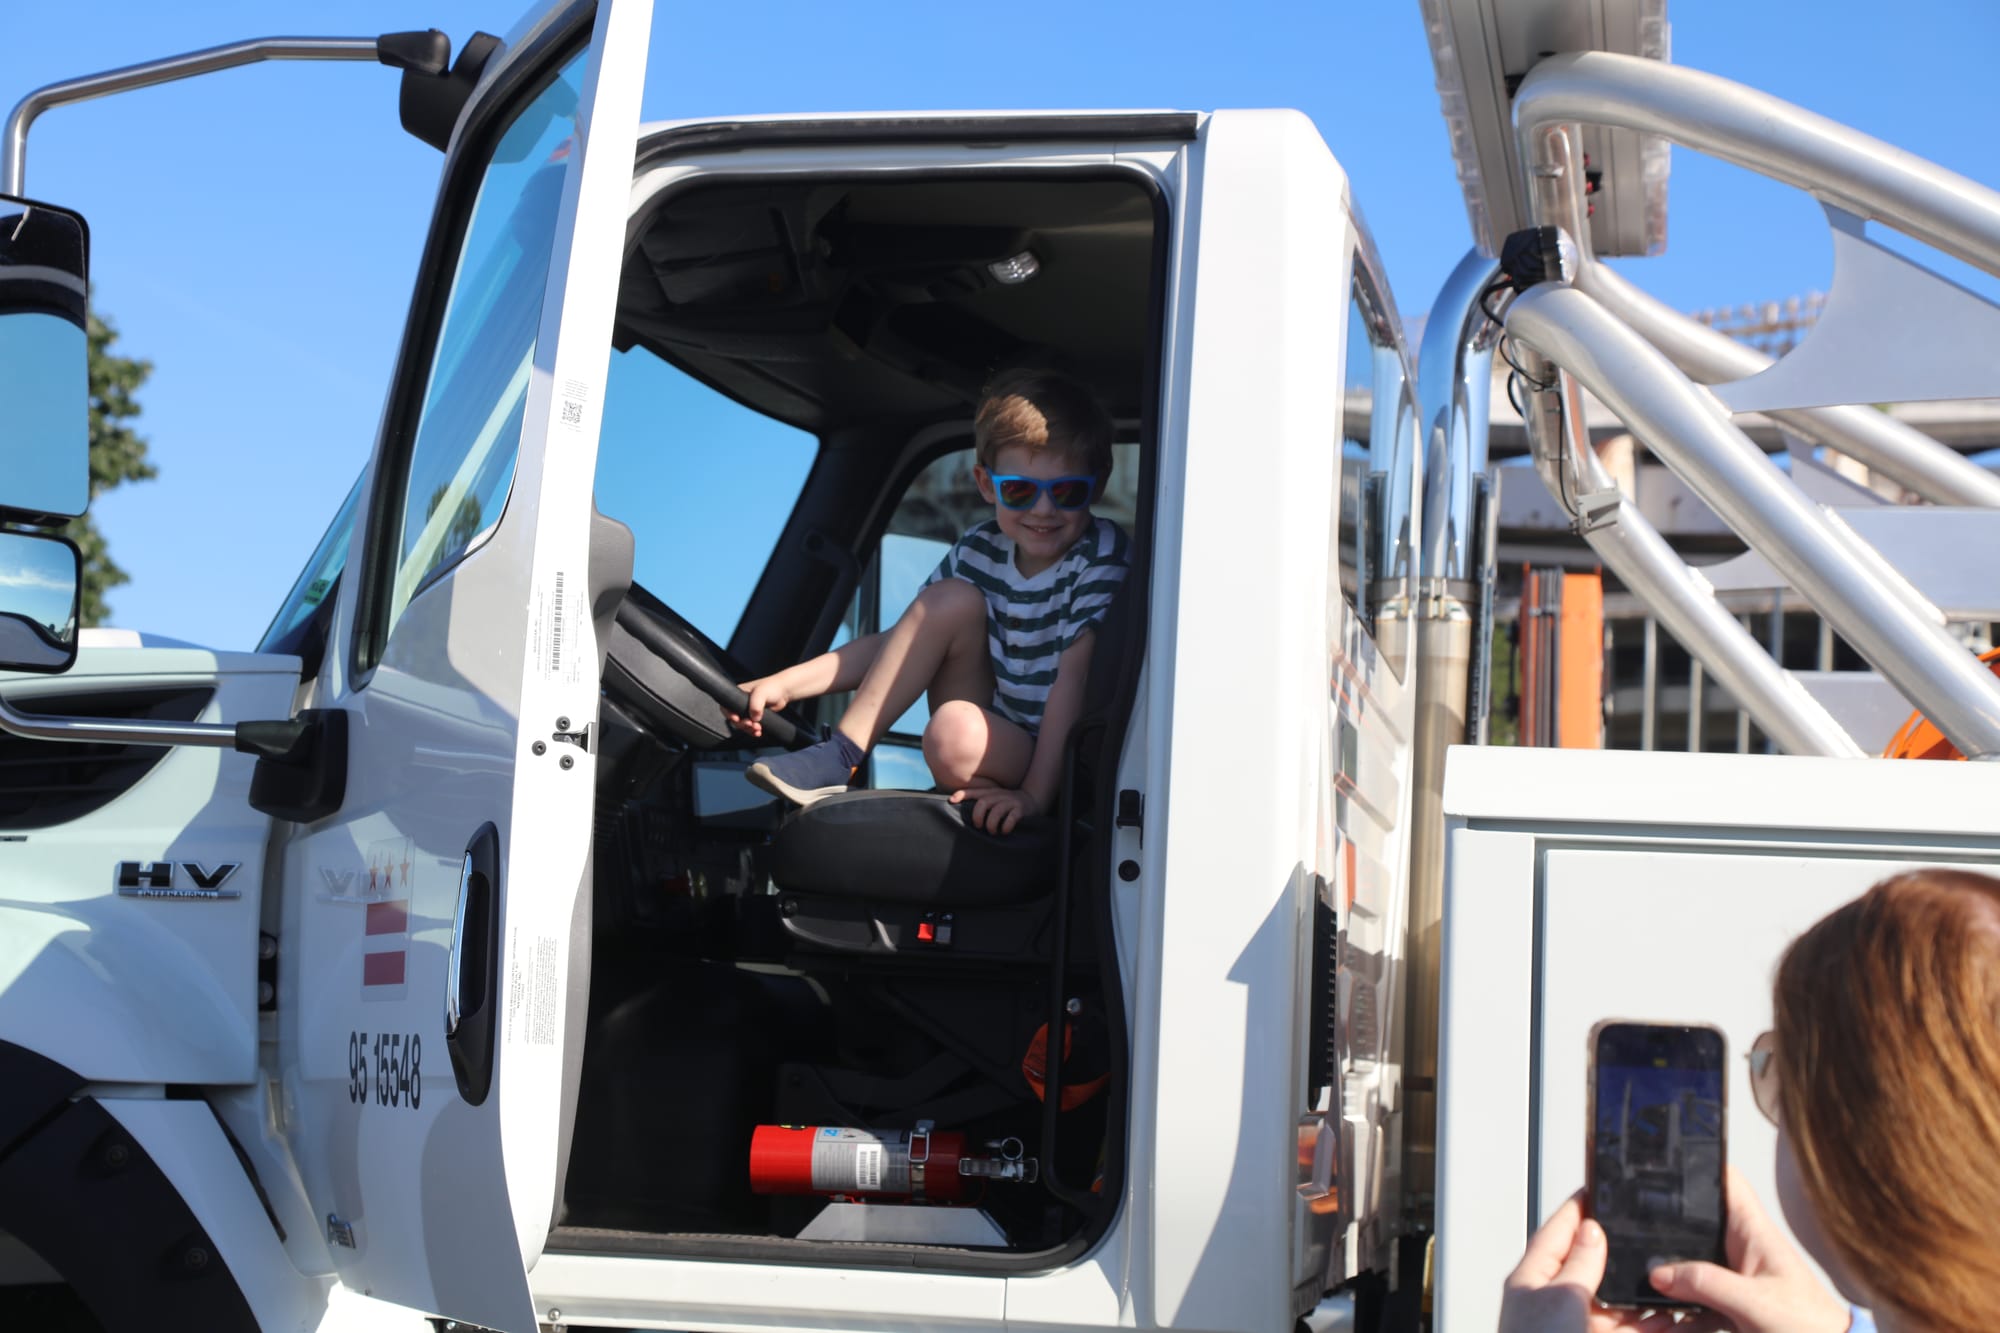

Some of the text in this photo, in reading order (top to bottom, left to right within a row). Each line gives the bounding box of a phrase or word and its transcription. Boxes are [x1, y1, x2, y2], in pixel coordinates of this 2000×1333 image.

[119, 861, 240, 889] HV
[349, 1031, 421, 1110] 95 15548
